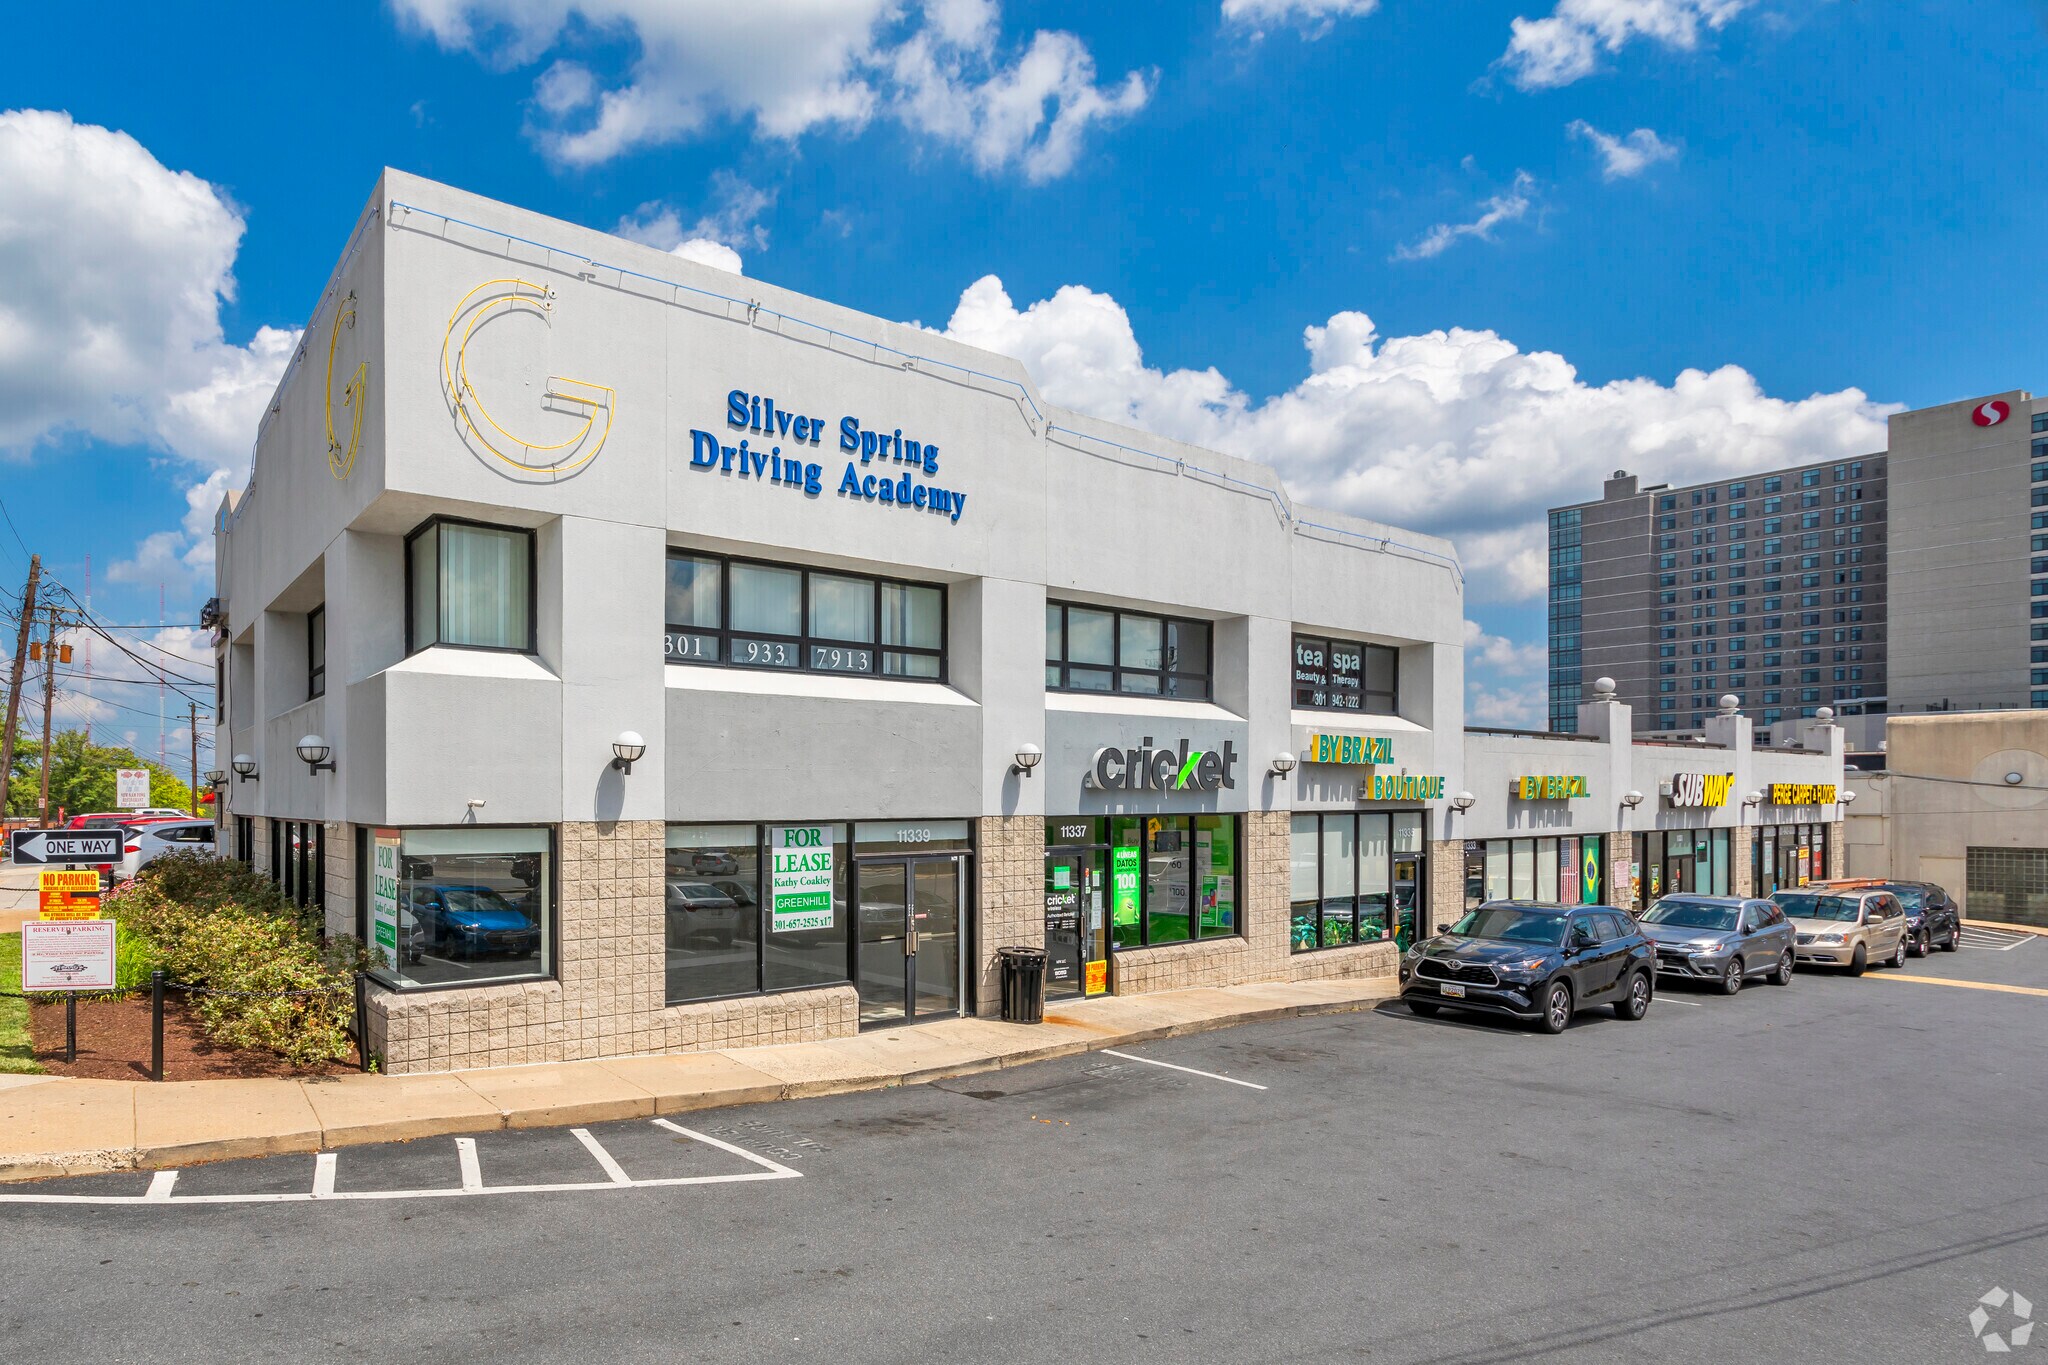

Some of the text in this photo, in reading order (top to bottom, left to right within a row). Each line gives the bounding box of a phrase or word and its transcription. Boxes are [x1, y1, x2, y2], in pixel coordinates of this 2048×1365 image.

[443, 278, 616, 475] G
[727, 389, 940, 474] Silver Spring
[689, 428, 967, 521] Driving Academy
[664, 634, 868, 671] 301 933 7913
[1296, 644, 1360, 674] tea spa
[1295, 669, 1359, 688] Beauty & Therapy
[1314, 691, 1359, 708] 301 942-1222
[1317, 734, 1395, 764] BY BRAZIL
[1094, 736, 1238, 791] cricket
[1373, 774, 1446, 801] BOUTIQUE
[1524, 775, 1591, 799] BY BRAZIL
[1674, 773, 1735, 807] SUBWAY
[1792, 783, 1813, 805] CARPET
[1817, 784, 1838, 805] FLOORS
[784, 828, 823, 848] FOR
[896, 829, 931, 843] 11339
[1060, 825, 1087, 838] 11337
[46, 840, 112, 854] ONE WAY
[378, 845, 393, 869] FOR
[774, 852, 832, 874] LEASE
[1116, 858, 1137, 868] DATOS
[43, 873, 97, 886] NO PARKING
[375, 873, 396, 901] LEASE
[774, 875, 832, 889] Kathy Coakley
[776, 897, 828, 909] GREENHILL
[1046, 893, 1076, 907] cricket
[774, 916, 832, 931] 301-657-2525 x17
